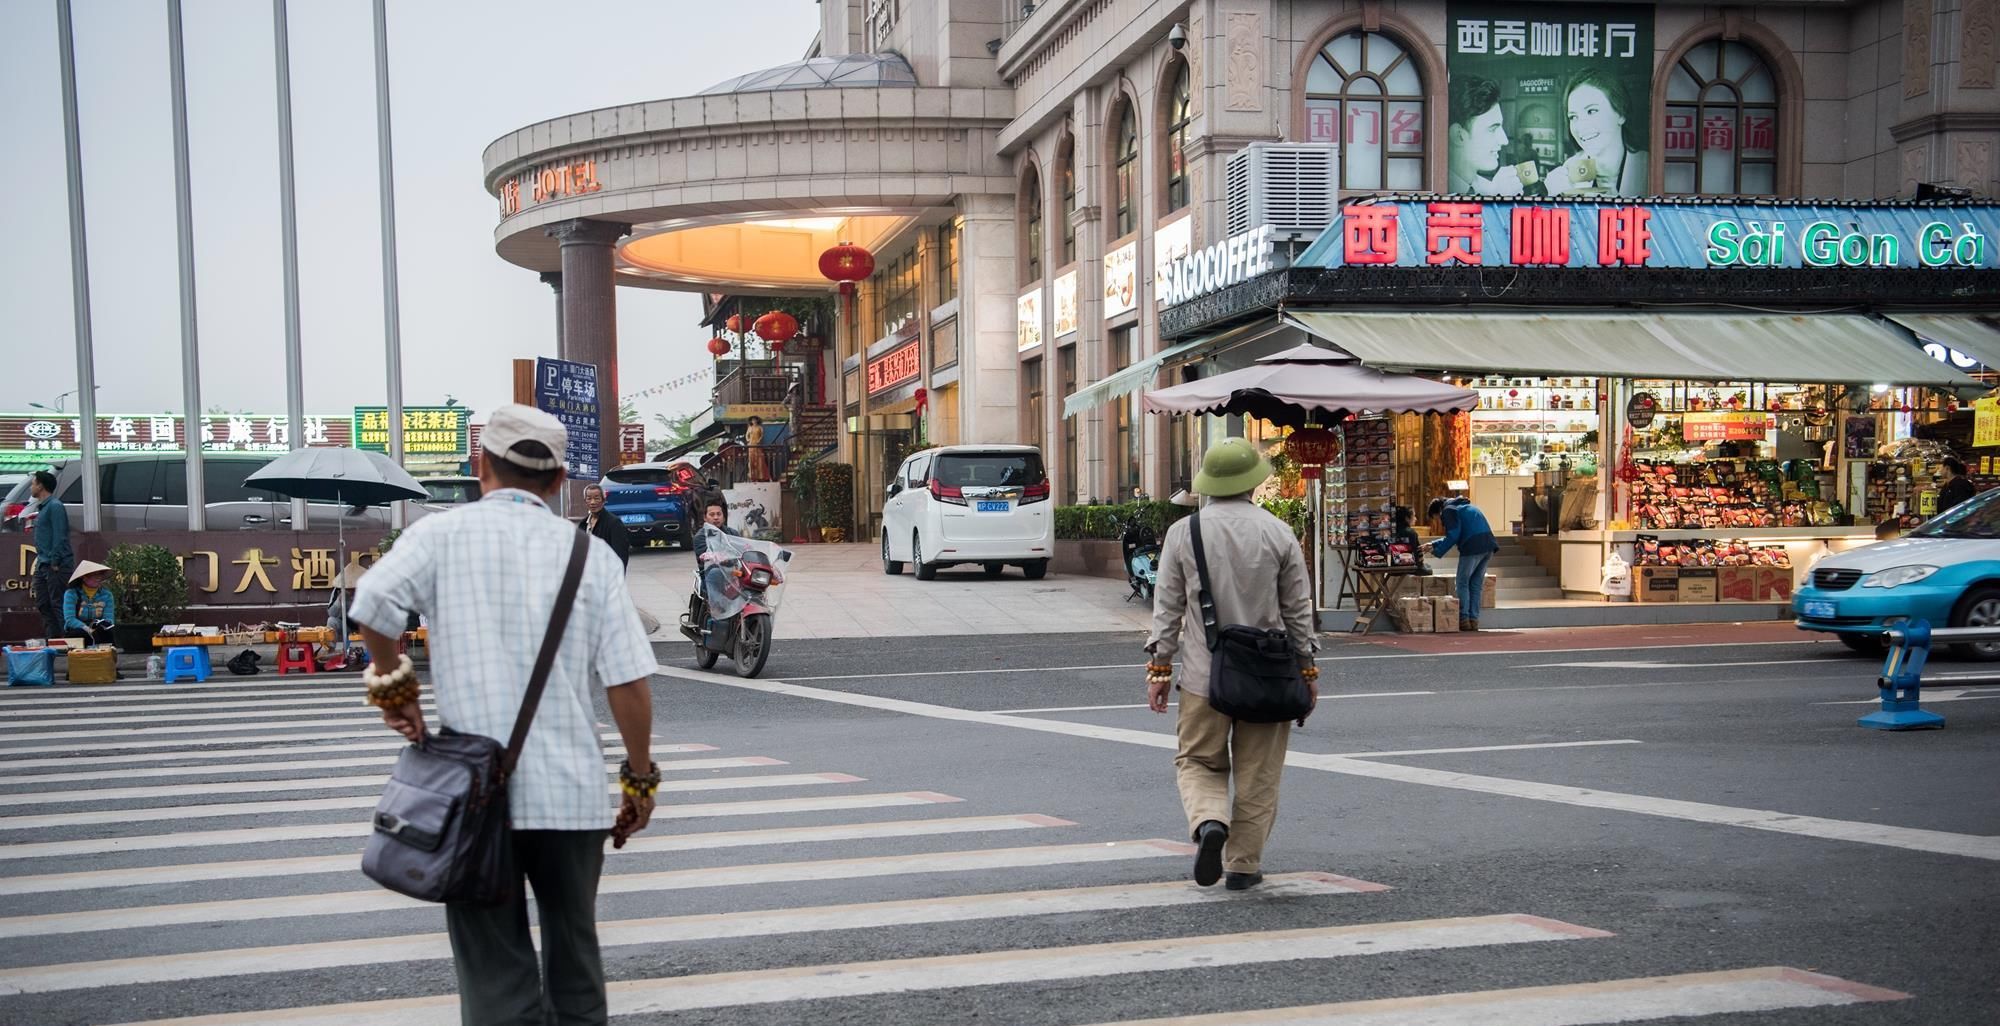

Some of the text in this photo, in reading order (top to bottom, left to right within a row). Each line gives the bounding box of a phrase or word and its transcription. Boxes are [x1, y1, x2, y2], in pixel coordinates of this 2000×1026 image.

[1457, 20, 1636, 57] 西贡咖啡厅
[1520, 79, 1554, 87] SAGOCOFFEE
[1305, 107, 1422, 144] 国门名
[1665, 115, 1775, 151] 品商场
[531, 160, 602, 203] HOTEL
[1344, 202, 1650, 265] 西贡咖啡
[1706, 220, 1786, 266] Sài
[1918, 220, 1985, 267] Cà
[1162, 224, 1276, 307] SAGOCOFFEE
[546, 366, 557, 387] P
[561, 376, 595, 398] 停车场
